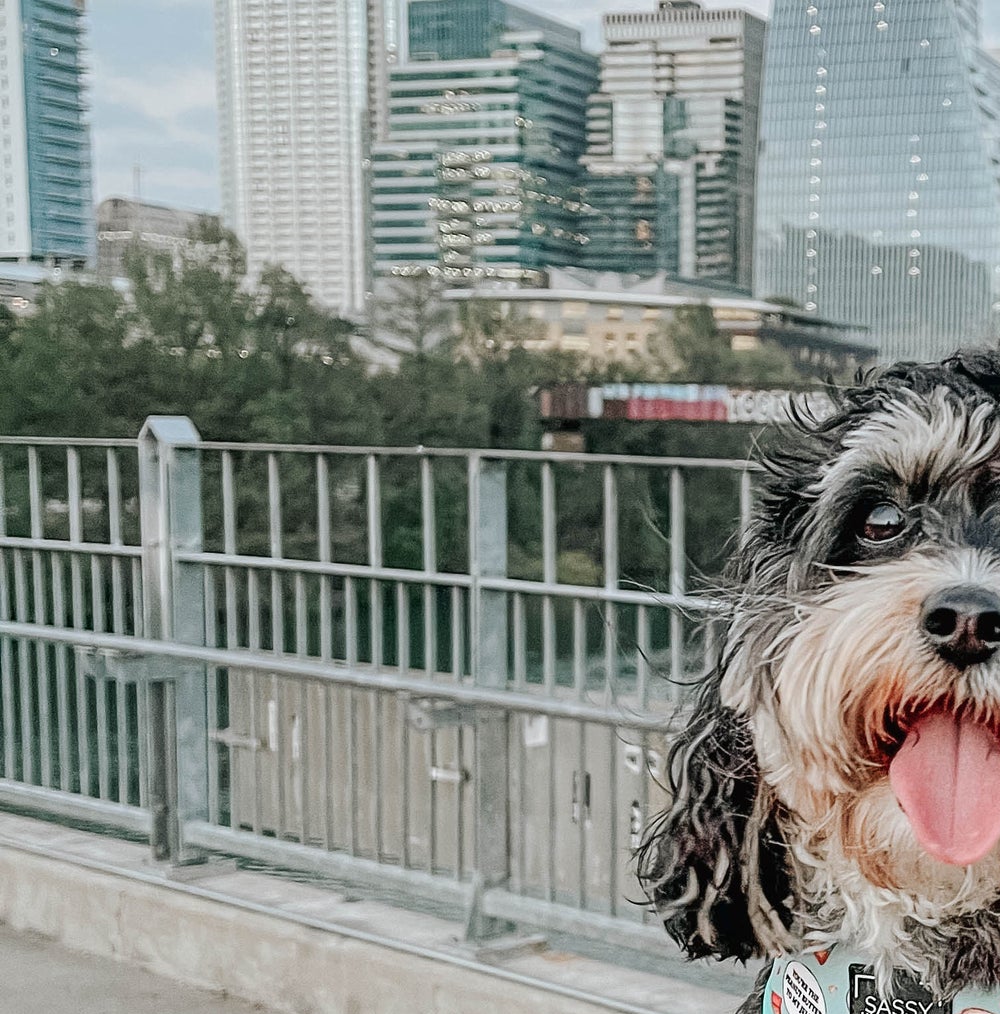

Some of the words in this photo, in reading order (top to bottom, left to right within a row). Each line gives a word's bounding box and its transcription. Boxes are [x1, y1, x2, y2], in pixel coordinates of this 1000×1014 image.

[785, 973, 802, 998] PEANUT
[808, 987, 820, 1004] THE
[786, 987, 793, 999] TO
[792, 996, 800, 1009] MY
